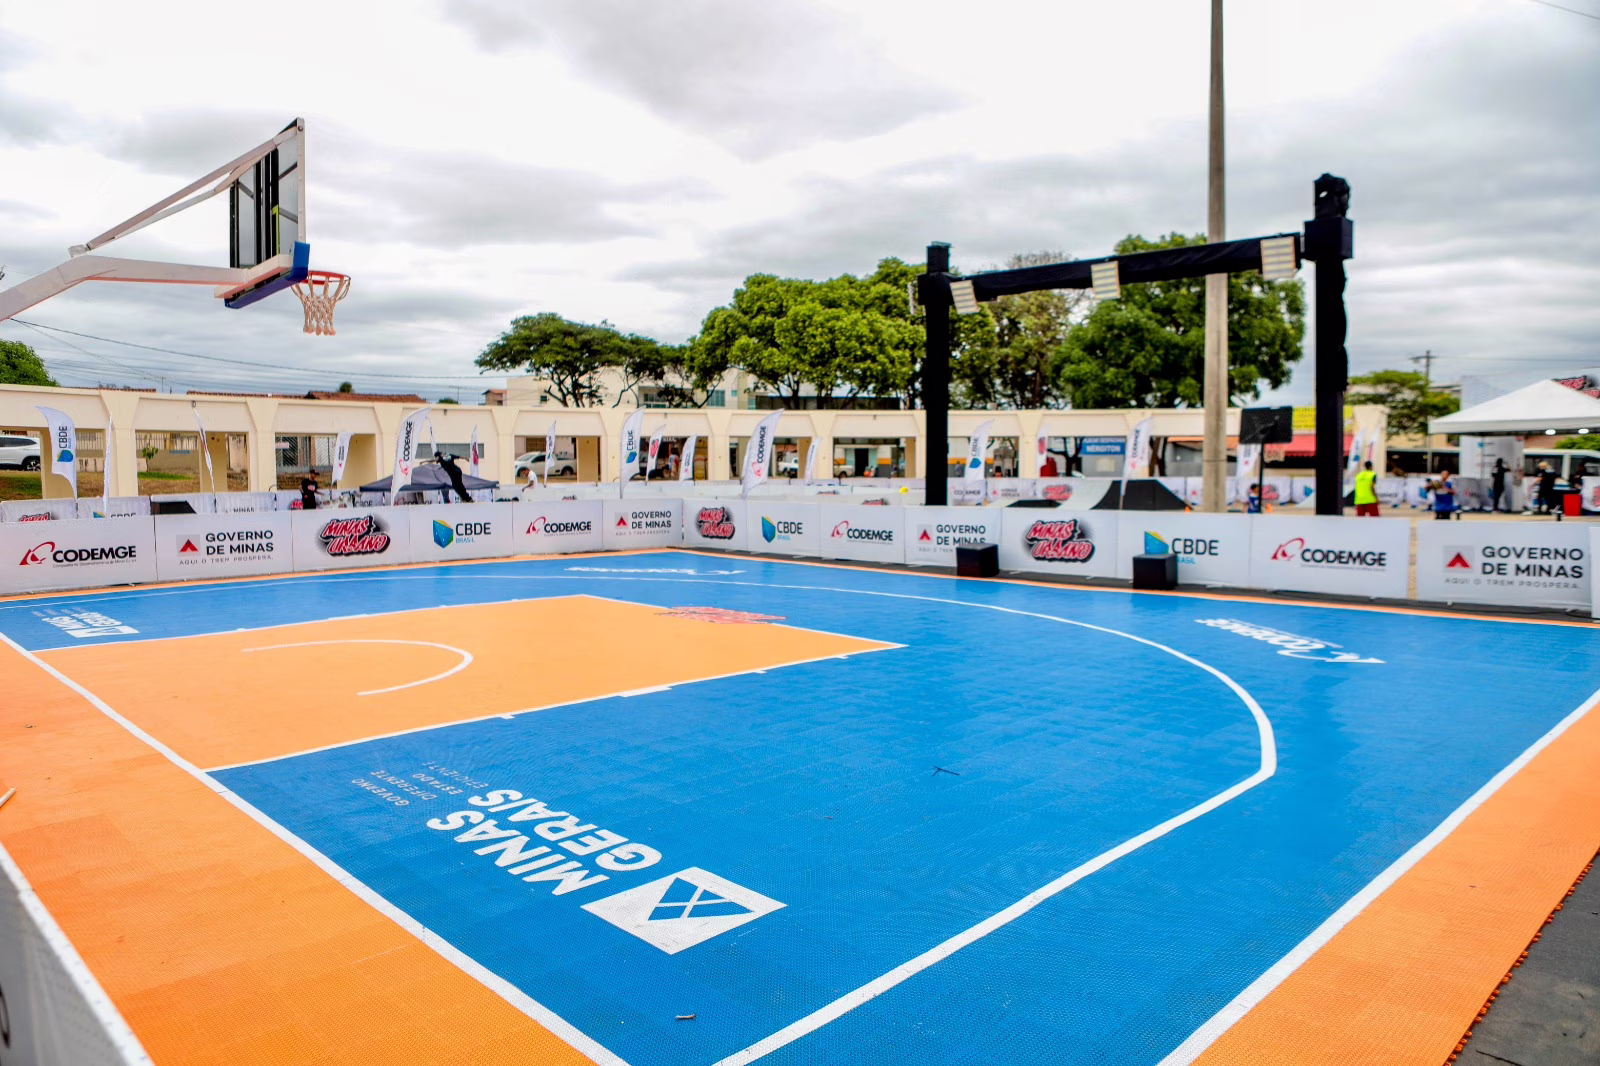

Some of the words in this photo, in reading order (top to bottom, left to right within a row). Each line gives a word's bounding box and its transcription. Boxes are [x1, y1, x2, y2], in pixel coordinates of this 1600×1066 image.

[59, 426, 67, 448] CBDE
[631, 511, 672, 519] GOVERNO
[455, 522, 491, 536] CBDE
[544, 521, 592, 533] CODEMGE
[631, 521, 643, 529] DE
[645, 520, 672, 529] MINAS
[777, 521, 803, 534] CBDE
[936, 524, 986, 534] GOVERNO
[205, 530, 274, 542] GOVERNO
[847, 528, 893, 541] CODEMGE
[936, 536, 950, 545] DE
[52, 545, 137, 563] CODEMGE
[206, 545, 225, 555] DE
[229, 542, 274, 554] MINAS
[1172, 538, 1219, 556] CBDE
[1481, 546, 1584, 561] GOVERNO
[1301, 548, 1387, 566] CODEMGE
[1482, 562, 1508, 575] DE
[1515, 564, 1584, 579] MINAS
[370, 770, 437, 800] DIFERENTE
[412, 773, 464, 795] ESTADO
[351, 778, 410, 806] GOVERNO
[467, 789, 663, 872] GERAIS
[426, 809, 610, 896] MINAS
